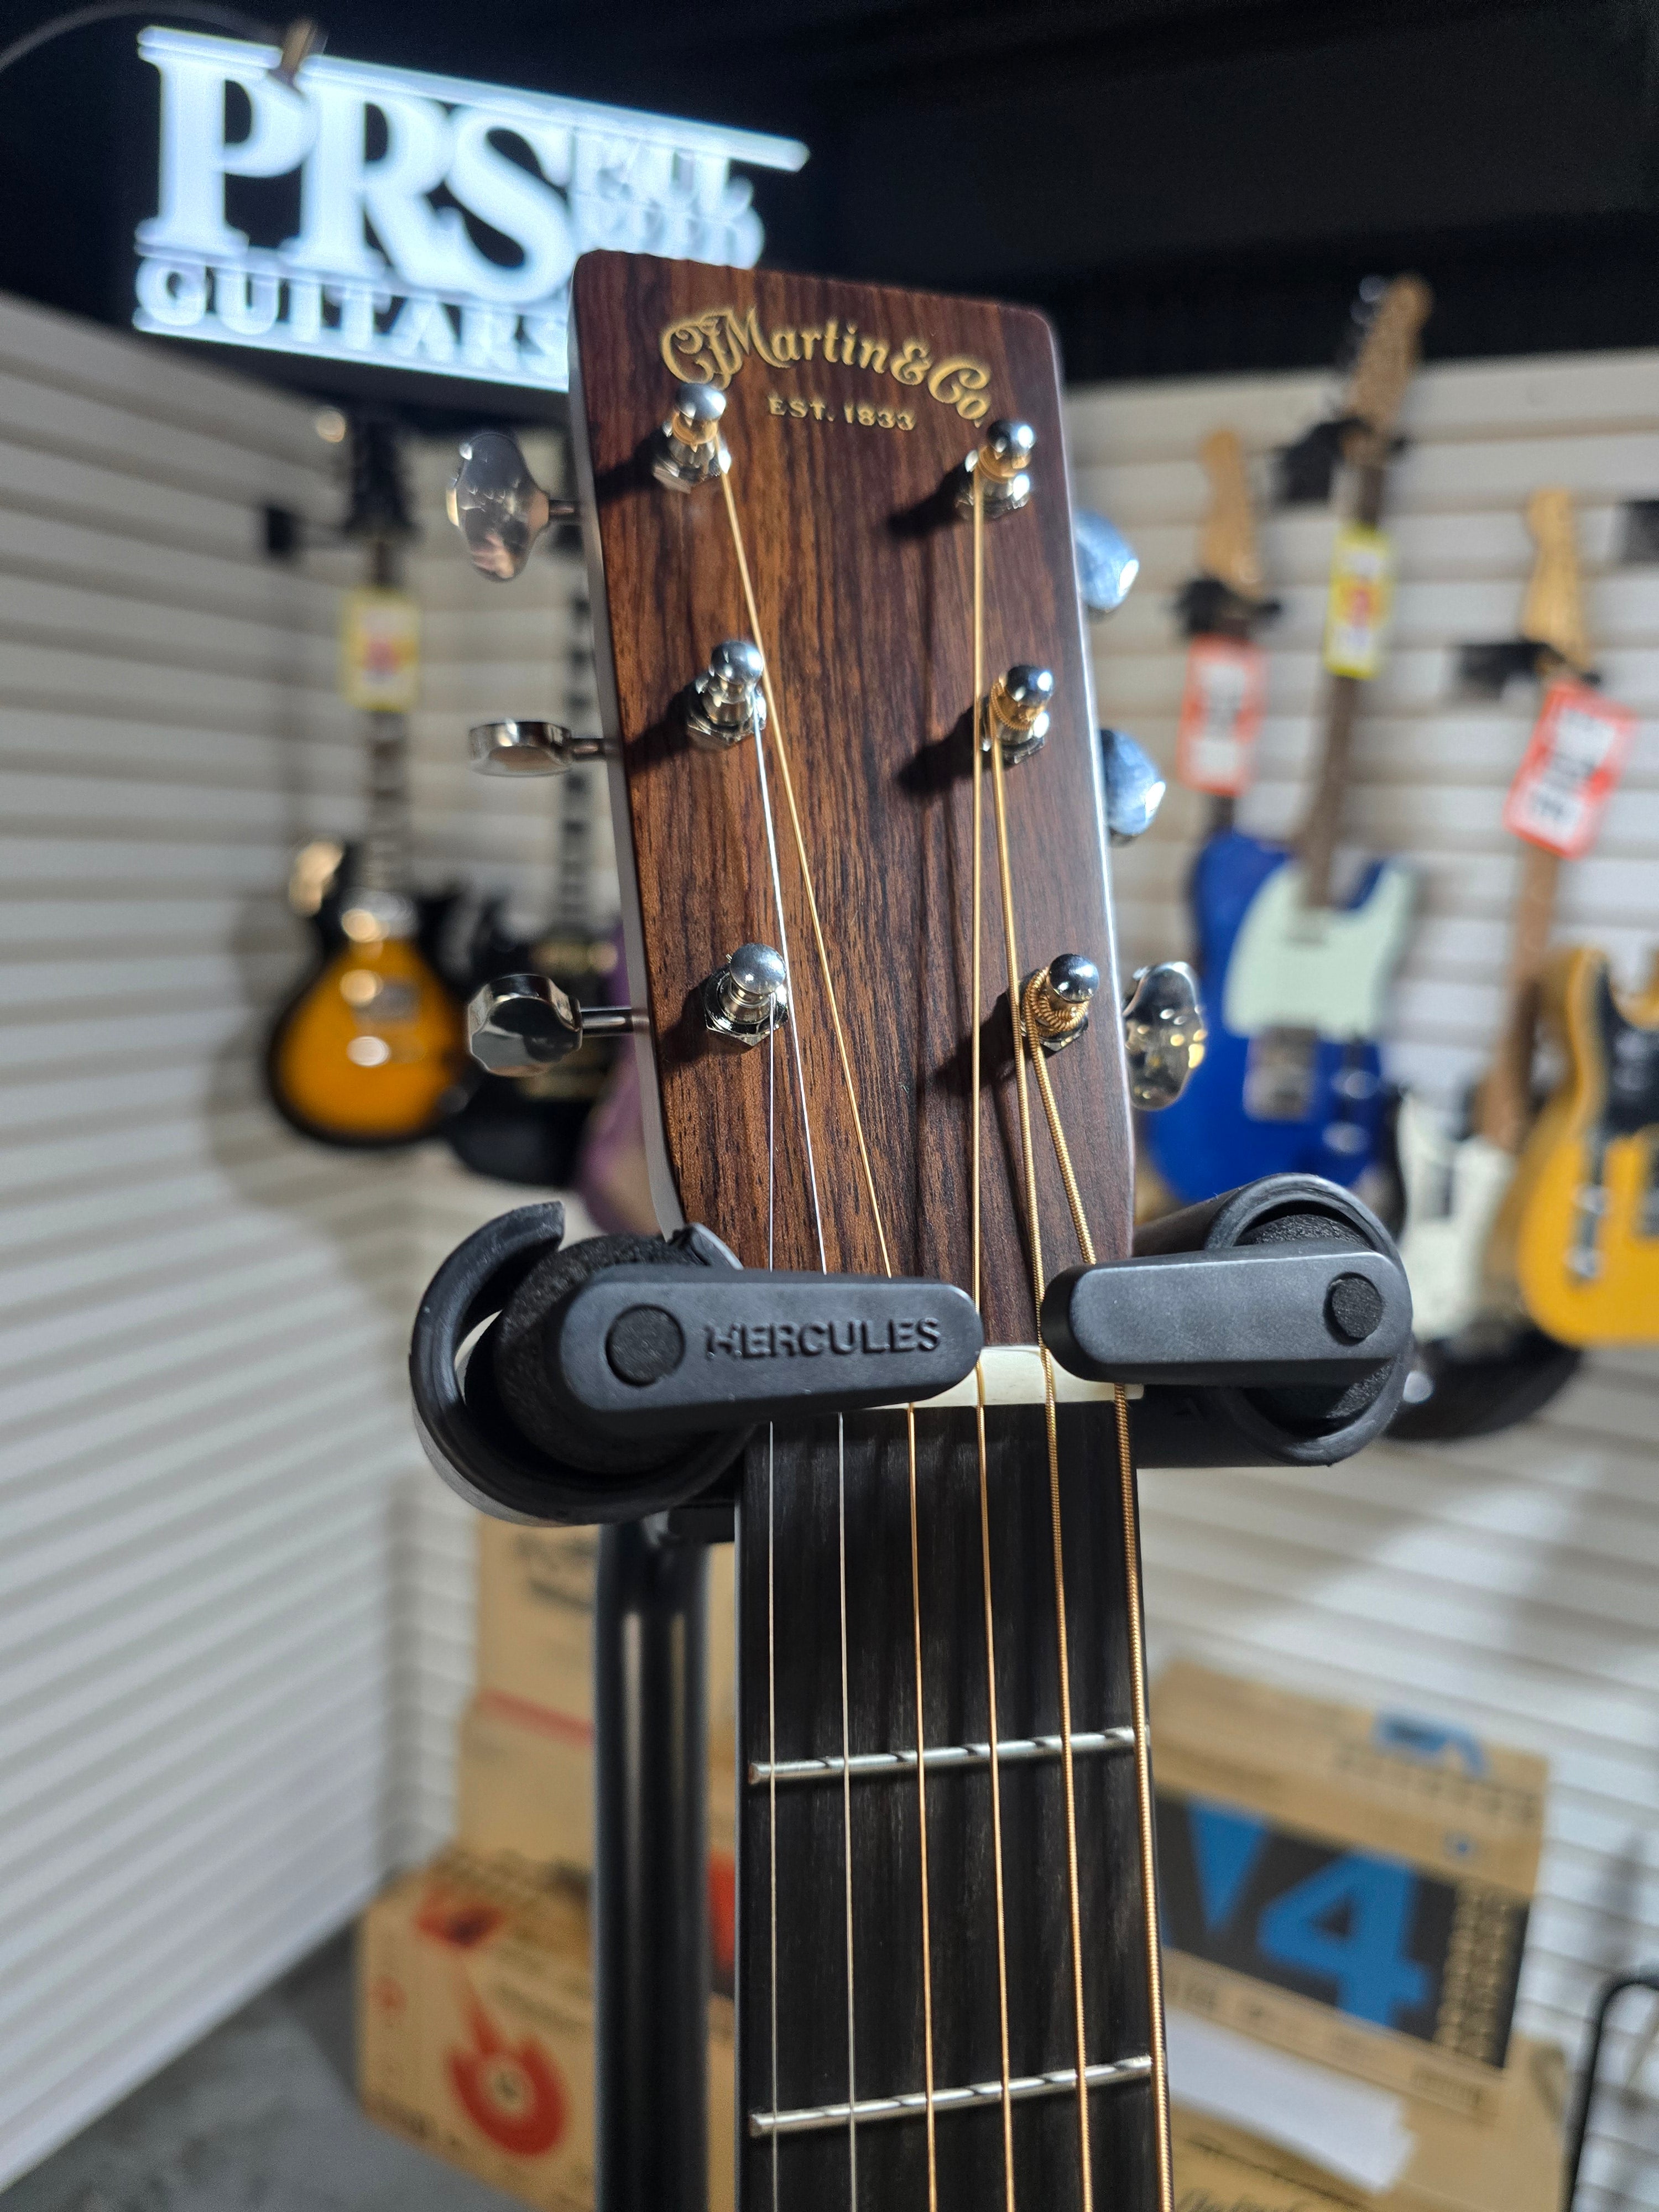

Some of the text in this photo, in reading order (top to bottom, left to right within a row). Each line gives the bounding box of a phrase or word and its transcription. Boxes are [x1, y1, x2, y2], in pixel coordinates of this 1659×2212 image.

[135, 41, 571, 304] PRS
[136, 255, 568, 379] GUITARS
[890, 338, 932, 385] &
[768, 390, 916, 431] EST. 1833
[706, 1317, 941, 1361] HERCULES
